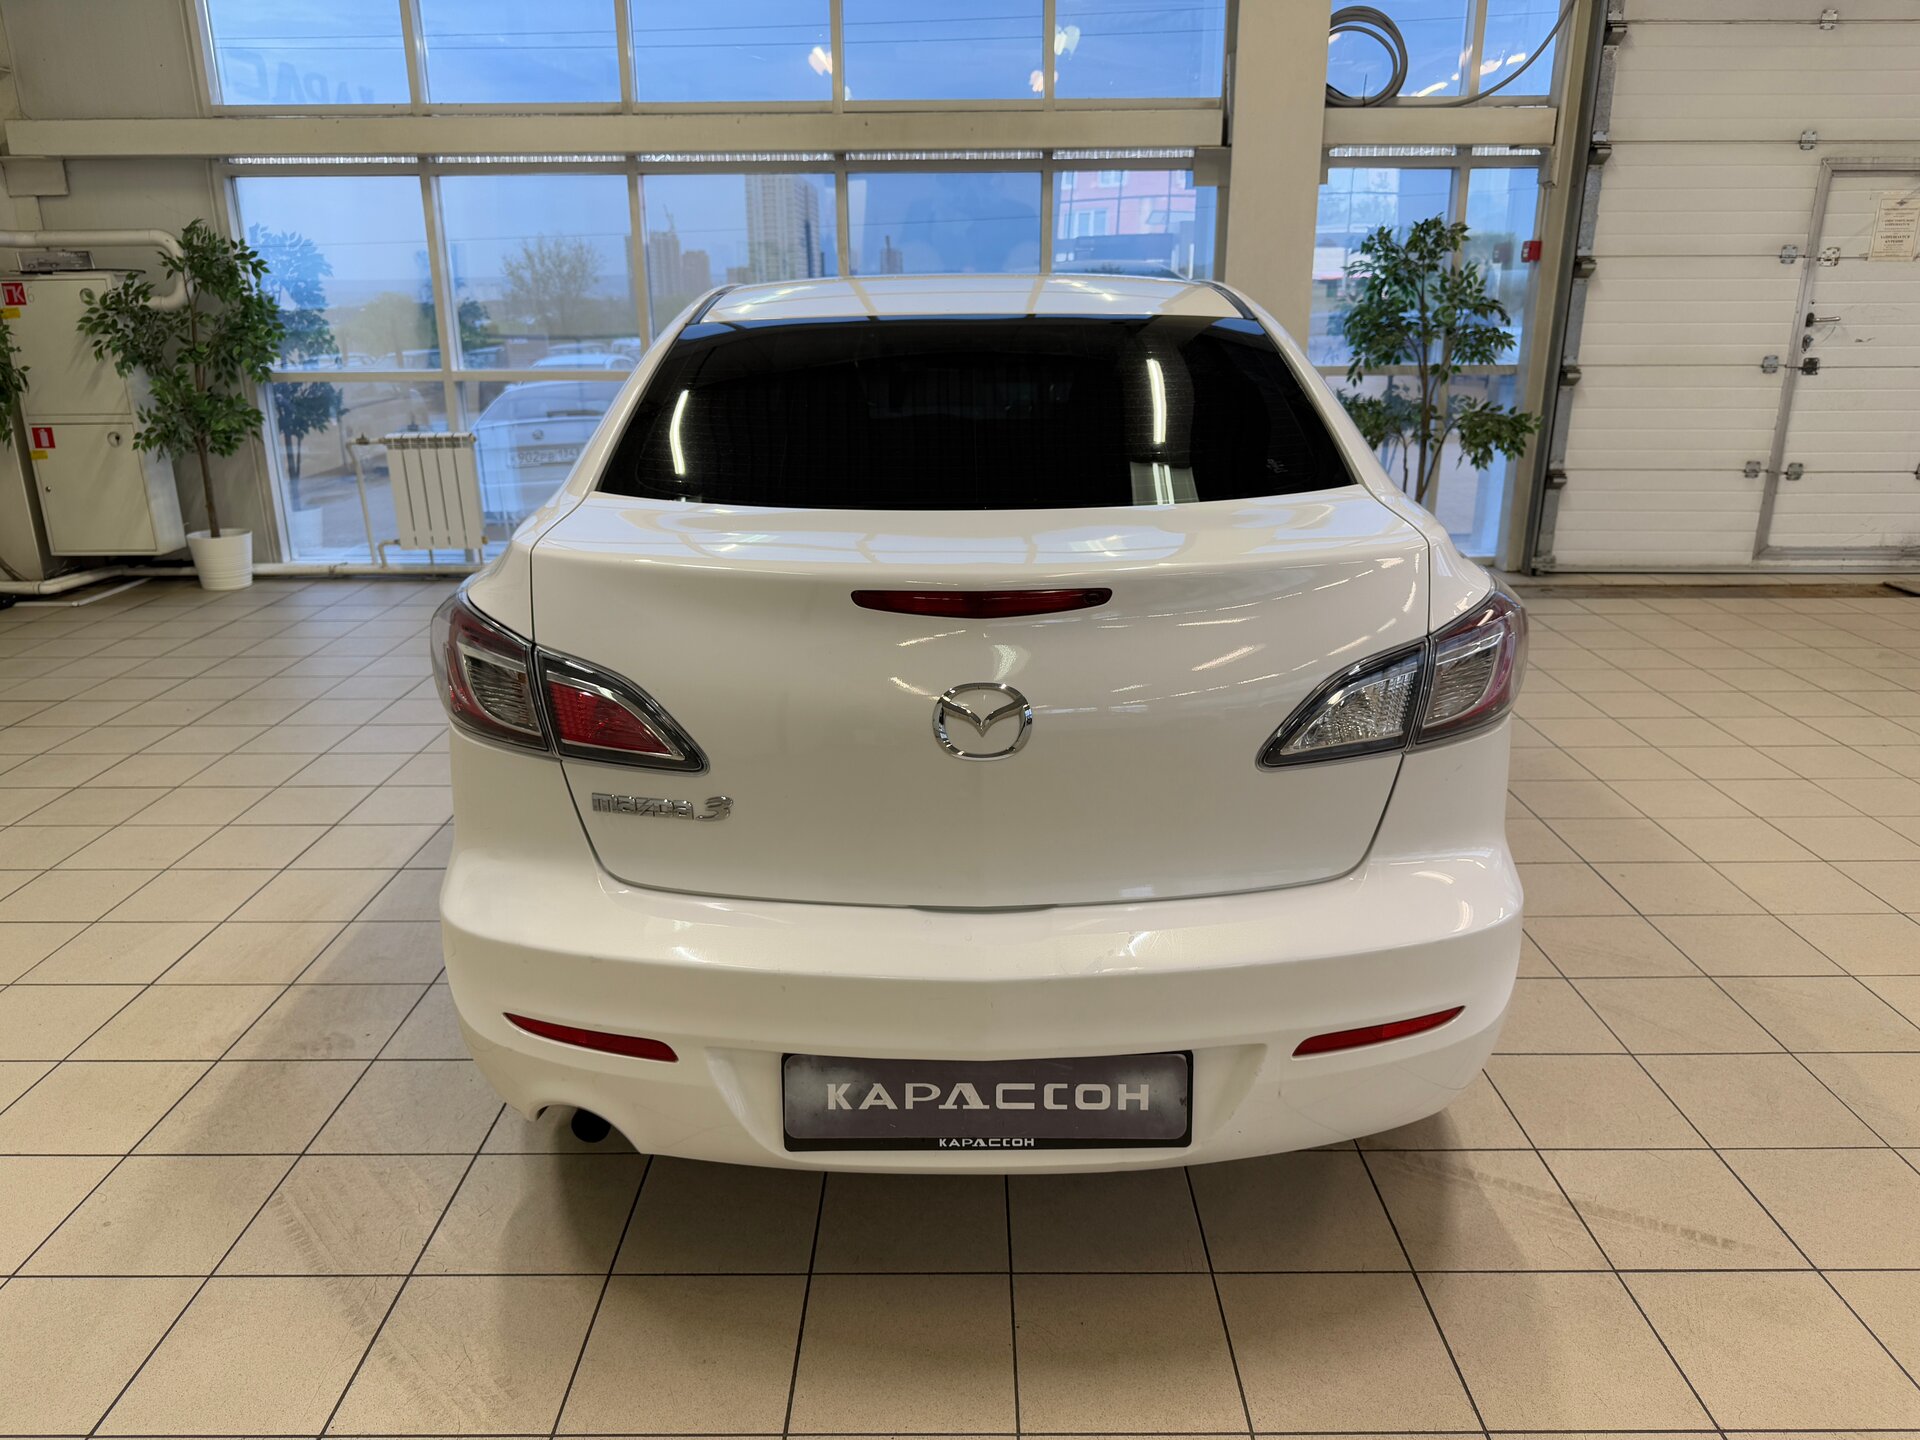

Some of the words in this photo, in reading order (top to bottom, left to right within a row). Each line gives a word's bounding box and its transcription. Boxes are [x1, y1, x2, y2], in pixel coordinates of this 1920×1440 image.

[3, 285, 25, 304] ПК
[827, 1082, 1149, 1111] КАРАССОН
[939, 1137, 1035, 1148] КАРАССОН
